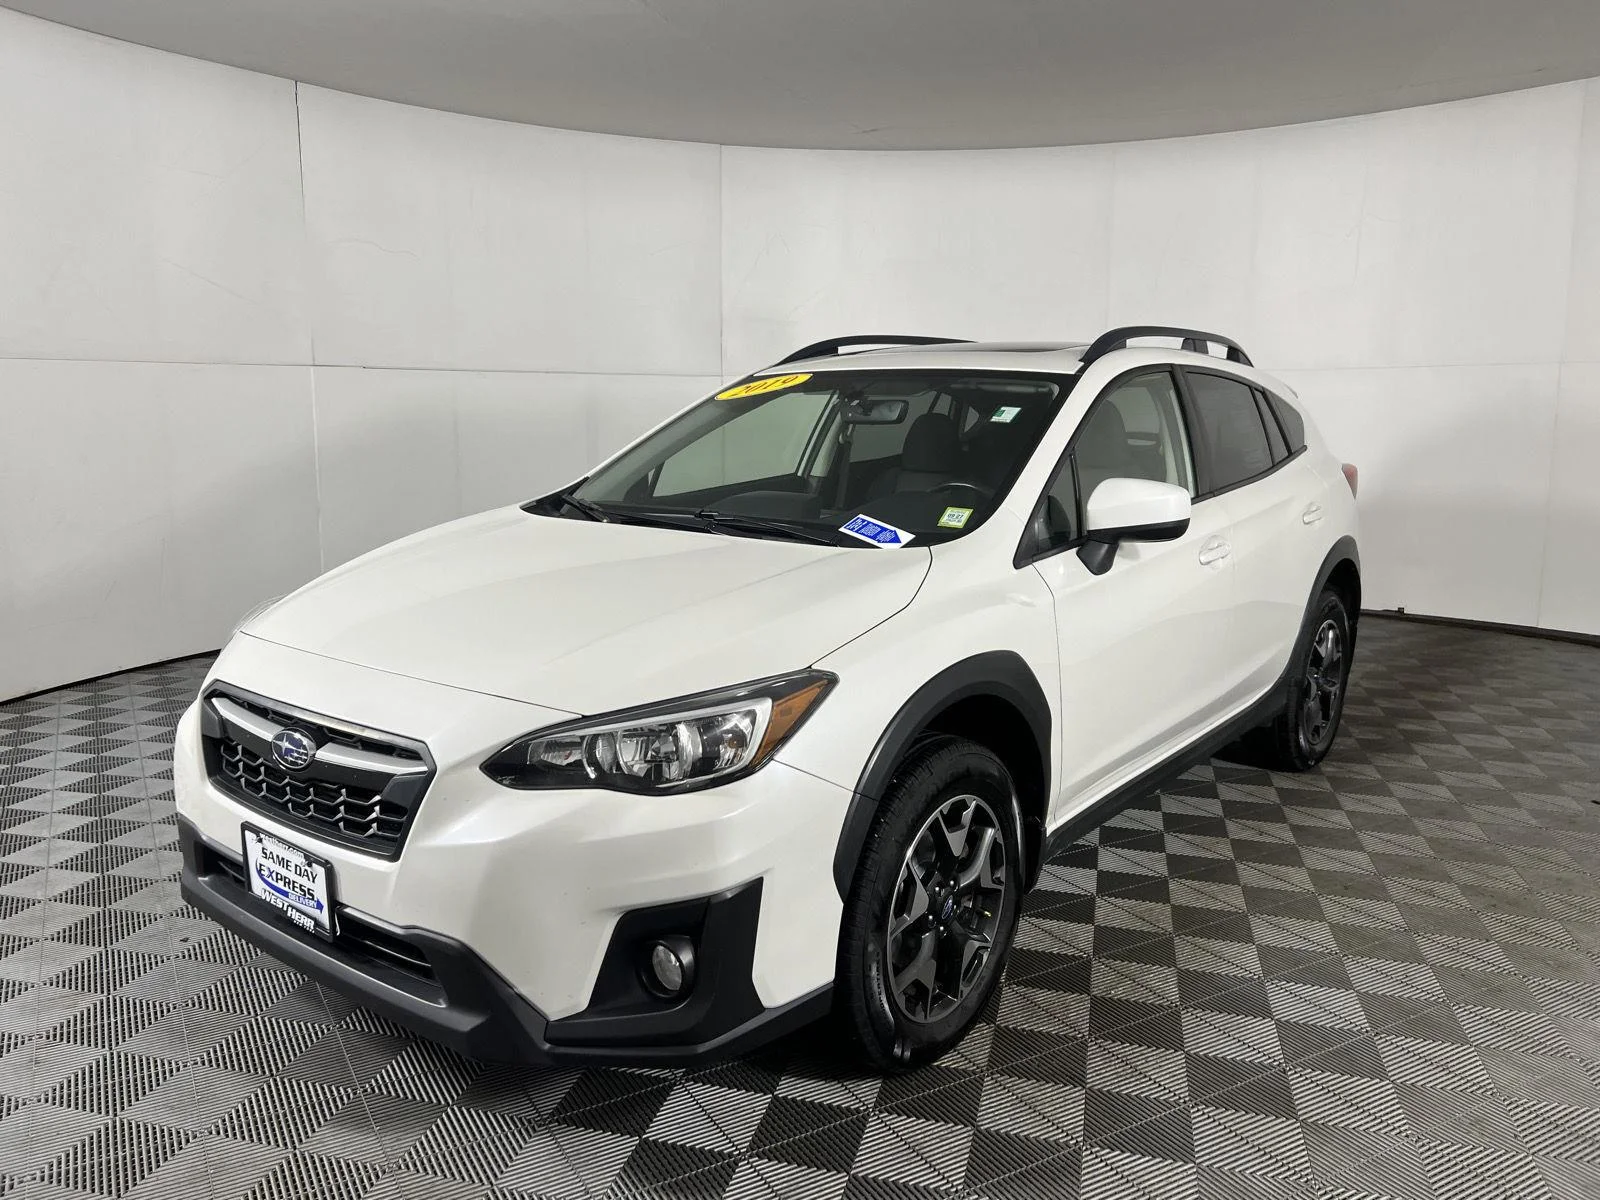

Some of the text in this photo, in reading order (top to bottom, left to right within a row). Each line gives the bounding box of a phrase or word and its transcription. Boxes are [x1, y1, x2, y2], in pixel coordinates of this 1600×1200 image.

[726, 375, 799, 398] 2019
[258, 862, 315, 901] EXPRESS
[261, 846, 318, 884] SAME DAY
[260, 888, 289, 911] WEST
[286, 906, 315, 930] HERR
